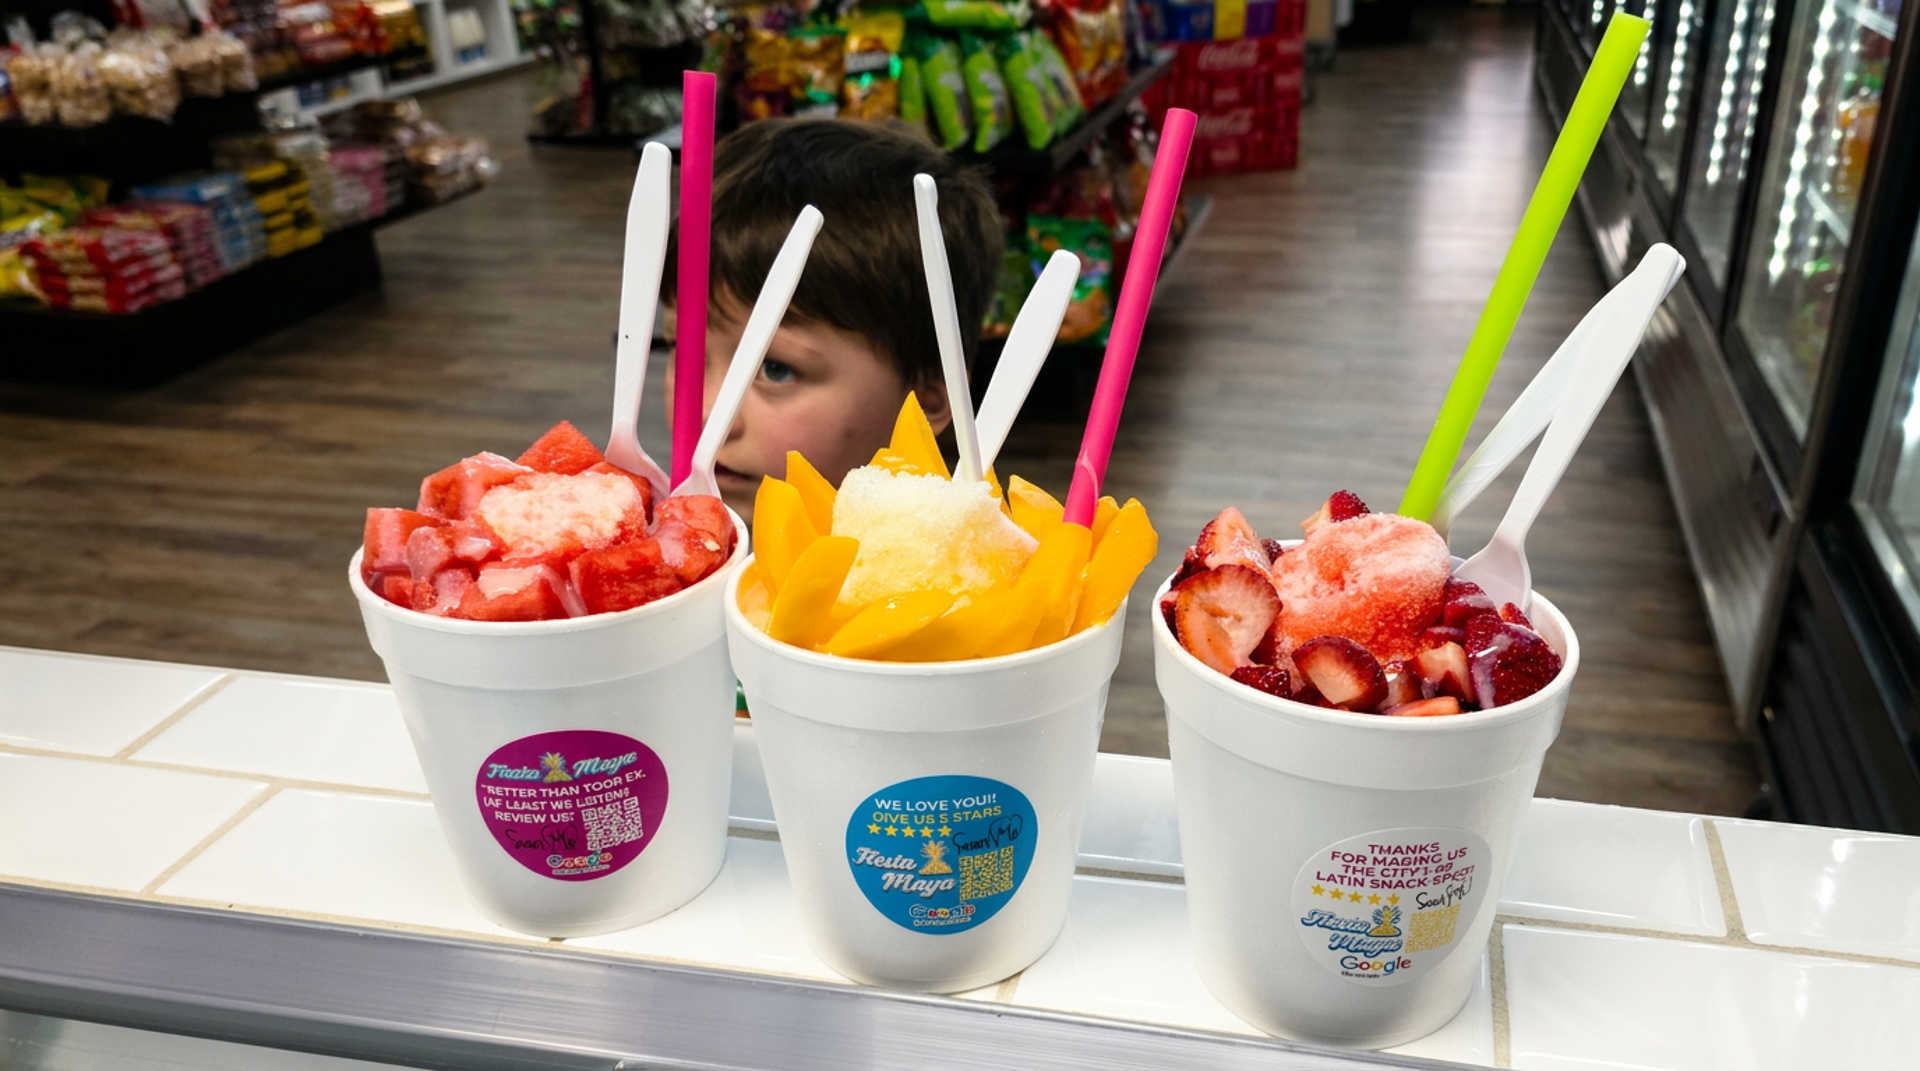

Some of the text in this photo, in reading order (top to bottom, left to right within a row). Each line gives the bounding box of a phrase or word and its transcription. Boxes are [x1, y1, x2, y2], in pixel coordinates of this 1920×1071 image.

[540, 786, 580, 798] THAN
[875, 798, 902, 811] WE
[906, 800, 948, 811] LOVE
[495, 811, 546, 823] REVIEW
[914, 814, 936, 825] US
[953, 805, 1002, 823] STARS
[1331, 850, 1368, 865] FOR
[1447, 847, 1468, 861] US
[1316, 870, 1366, 888] LATIN
[1341, 864, 1376, 877] THE
[881, 872, 957, 898] Maya
[1340, 955, 1412, 974] Google
